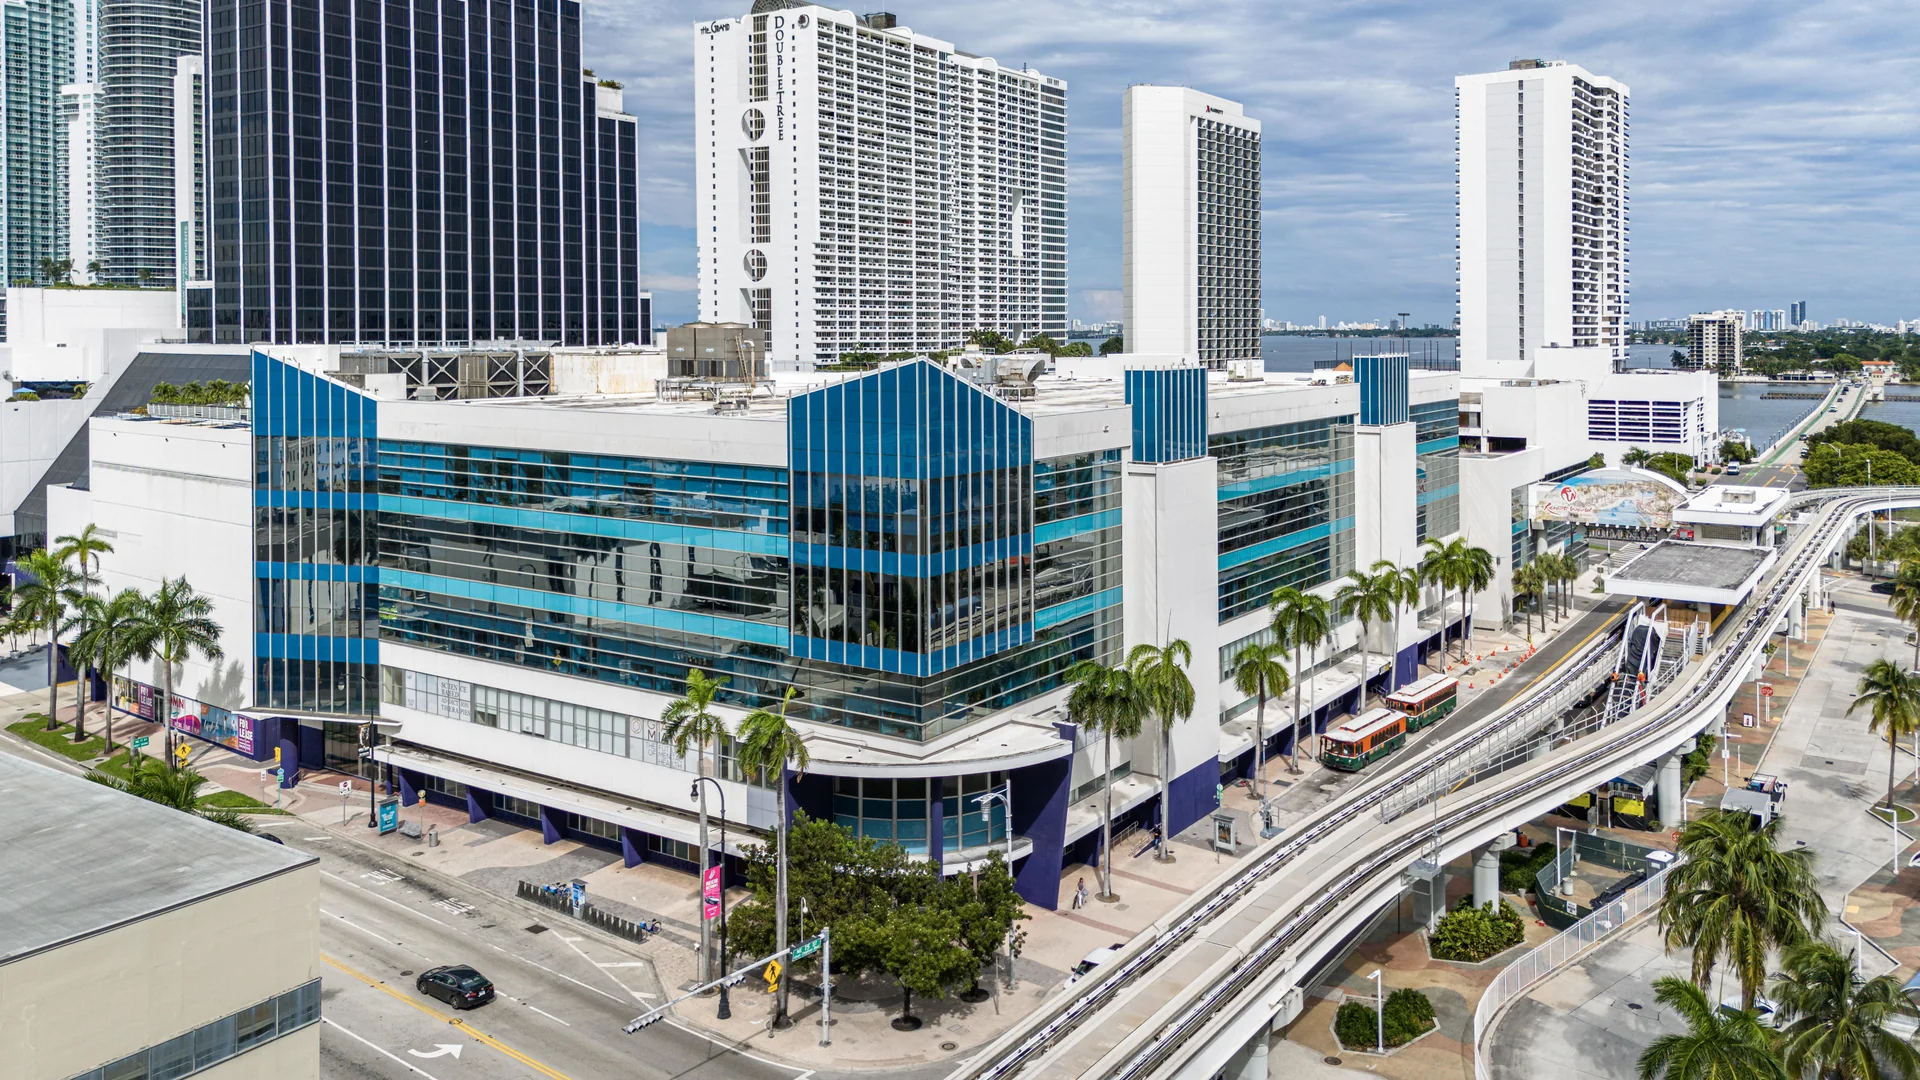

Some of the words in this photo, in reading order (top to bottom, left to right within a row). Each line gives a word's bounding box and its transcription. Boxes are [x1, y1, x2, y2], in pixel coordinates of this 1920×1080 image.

[774, 16, 785, 141] DOUBLETREE
[140, 686, 149, 697] FOR
[441, 682, 468, 694] SCIENCE
[441, 689, 460, 698] BASED
[140, 695, 153, 707] LEASE
[441, 704, 471, 716] THERAPIES
[239, 718, 249, 730] FOR
[239, 728, 253, 740] LEASE
